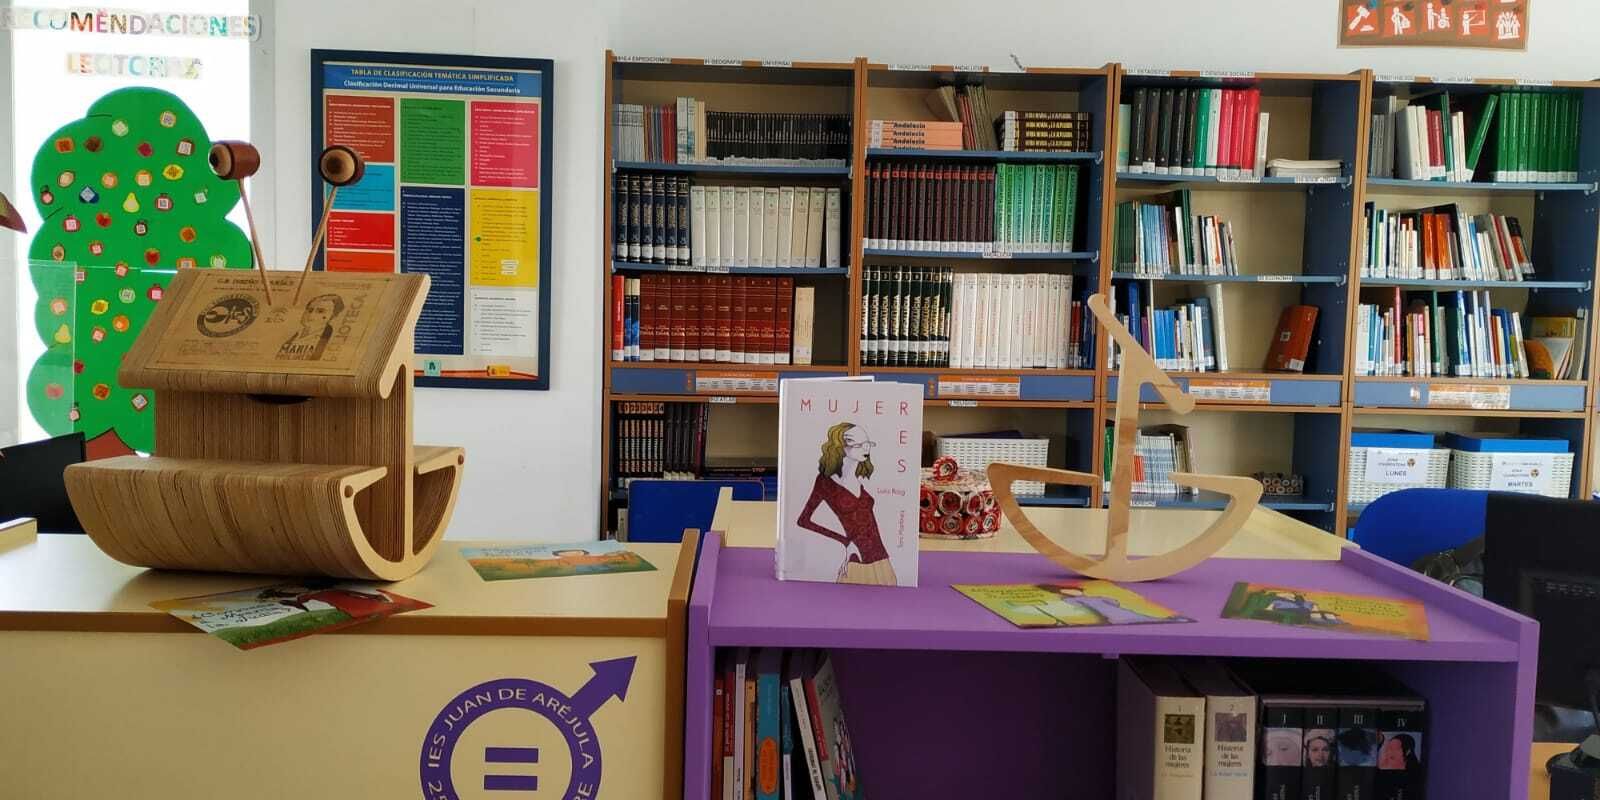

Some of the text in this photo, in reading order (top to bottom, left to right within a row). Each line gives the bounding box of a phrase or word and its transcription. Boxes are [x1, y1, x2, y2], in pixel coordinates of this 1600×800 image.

[383, 70, 433, 78] CLASIFICACIÓN
[434, 72, 466, 80] TEMÁTICA
[468, 74, 514, 82] SIMPLIFICADA
[343, 80, 382, 88] Clasificación
[409, 82, 438, 90] Universal
[454, 84, 485, 92] Educación
[428, 688, 594, 769] IES JUAN DE ARÉJULA
[1165, 745, 1191, 753] Historia
[1217, 744, 1243, 752] Historia
[1217, 760, 1242, 768] mujeres
